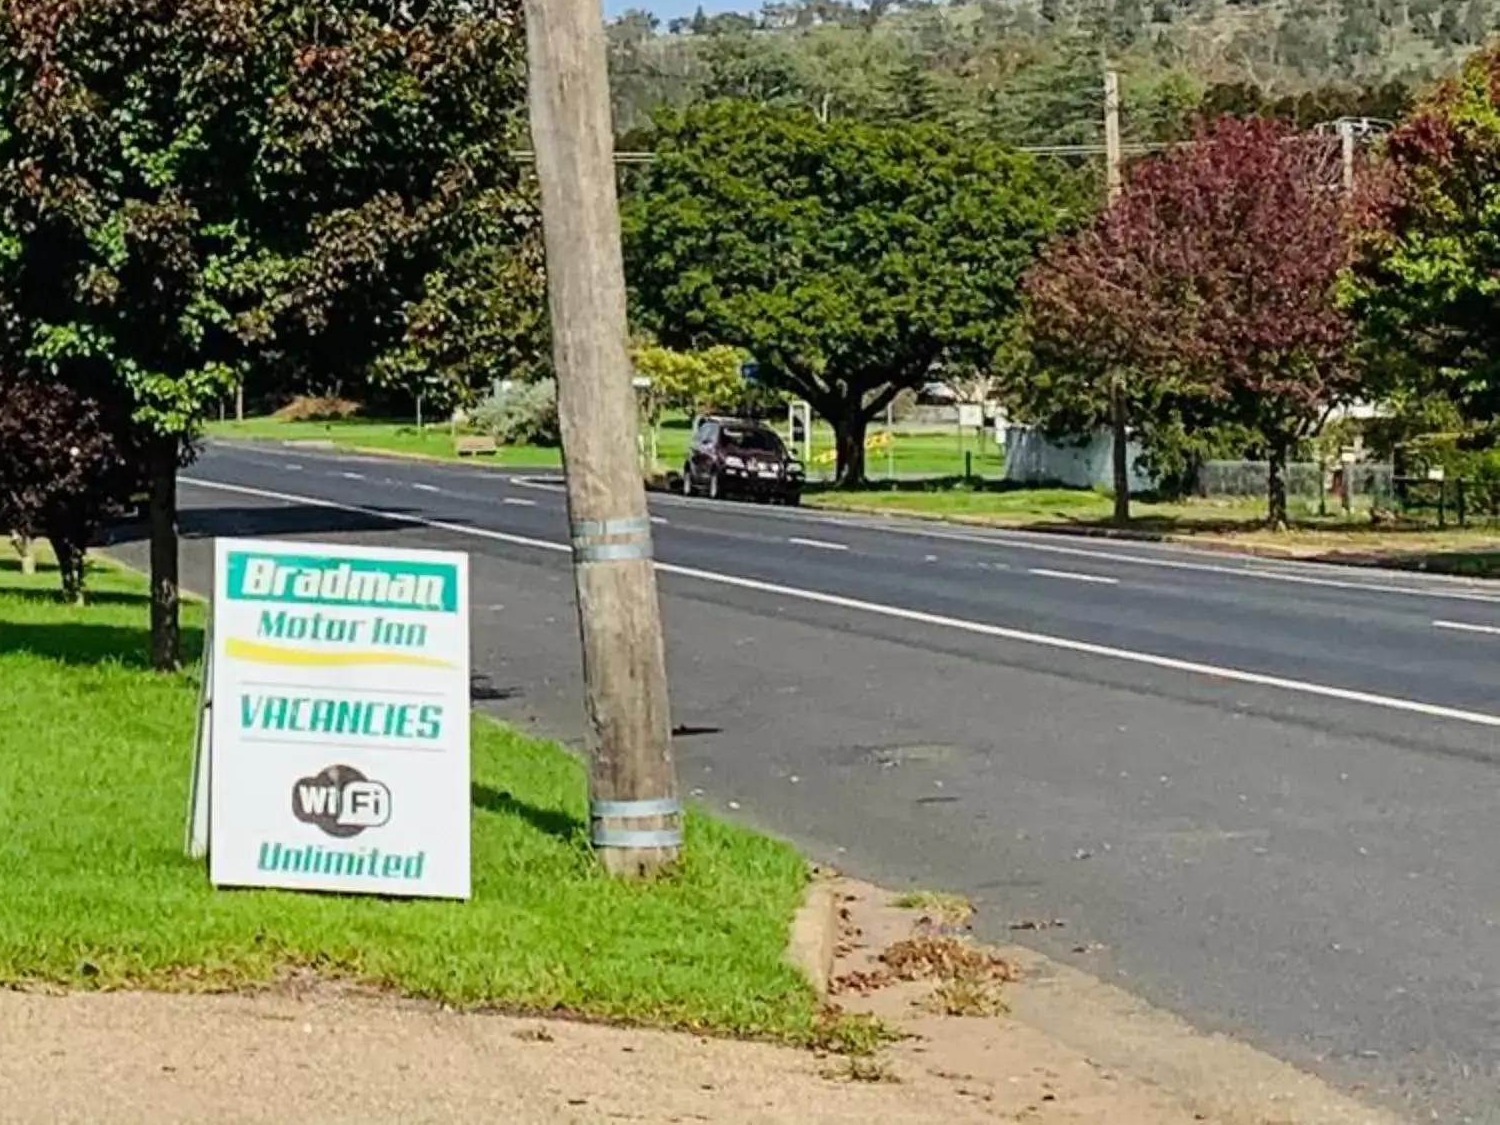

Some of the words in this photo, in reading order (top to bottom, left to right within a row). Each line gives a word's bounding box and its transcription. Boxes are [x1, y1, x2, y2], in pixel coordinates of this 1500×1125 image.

[242, 559, 444, 608] Bradman
[258, 610, 364, 644] Motor
[372, 615, 426, 647] Inn
[240, 694, 444, 739] VACANCIES
[298, 784, 381, 816] WiFi
[257, 841, 425, 880] Unlimited
